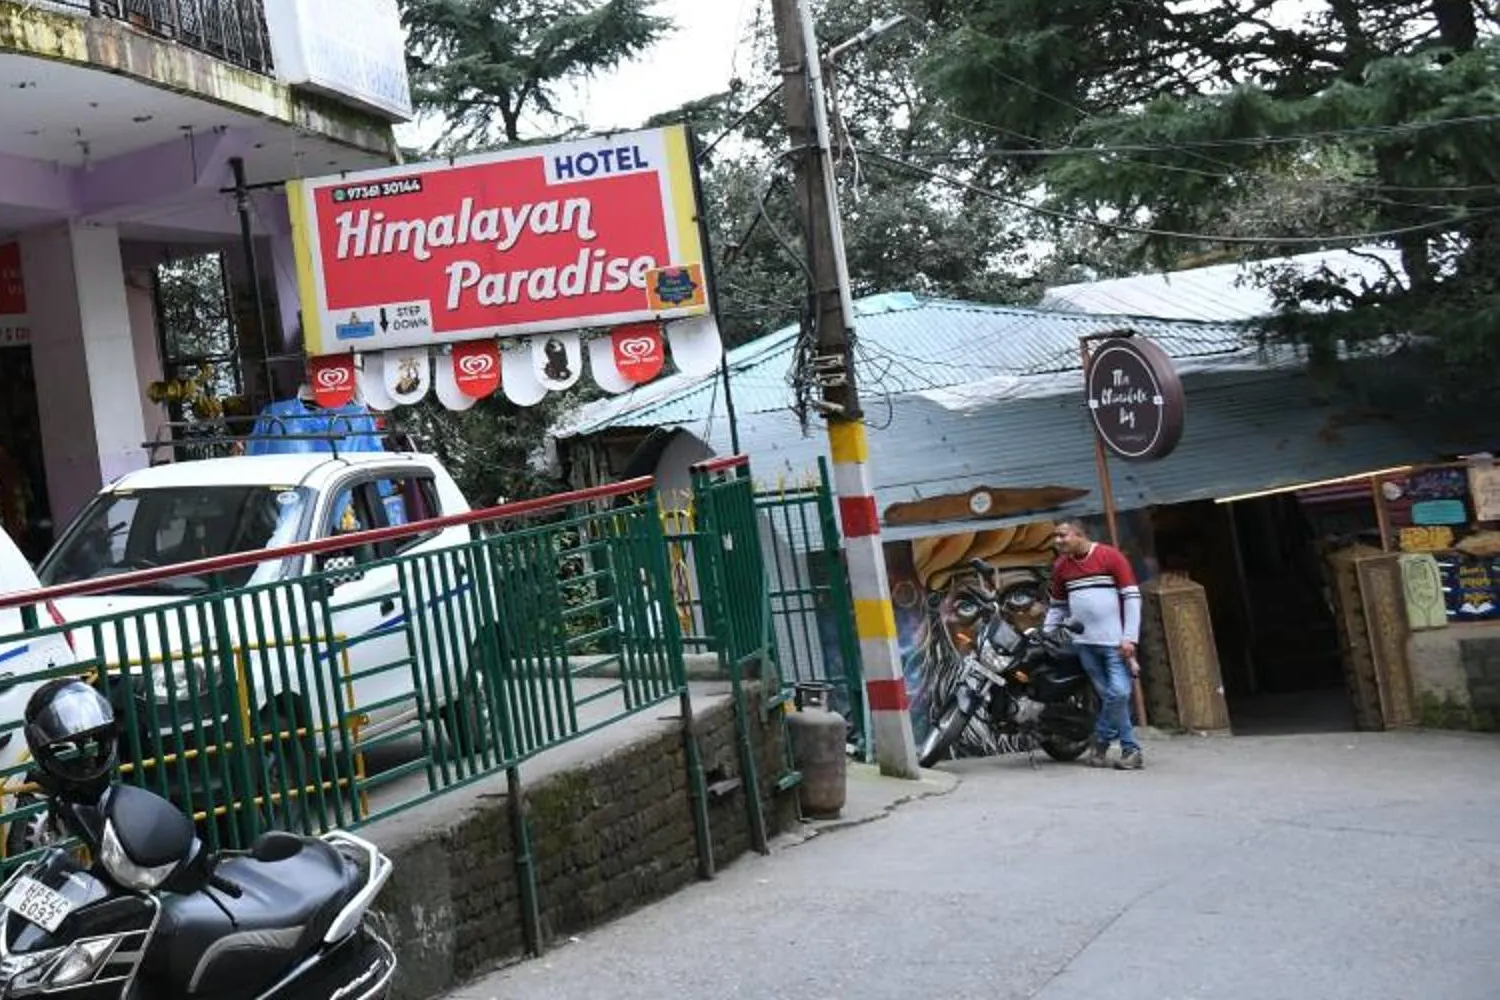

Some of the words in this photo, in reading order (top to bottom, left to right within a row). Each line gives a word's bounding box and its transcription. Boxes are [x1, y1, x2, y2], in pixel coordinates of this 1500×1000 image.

[555, 145, 649, 179] HOTEL
[335, 197, 596, 261] Himalayan
[445, 248, 655, 311] Paradise
